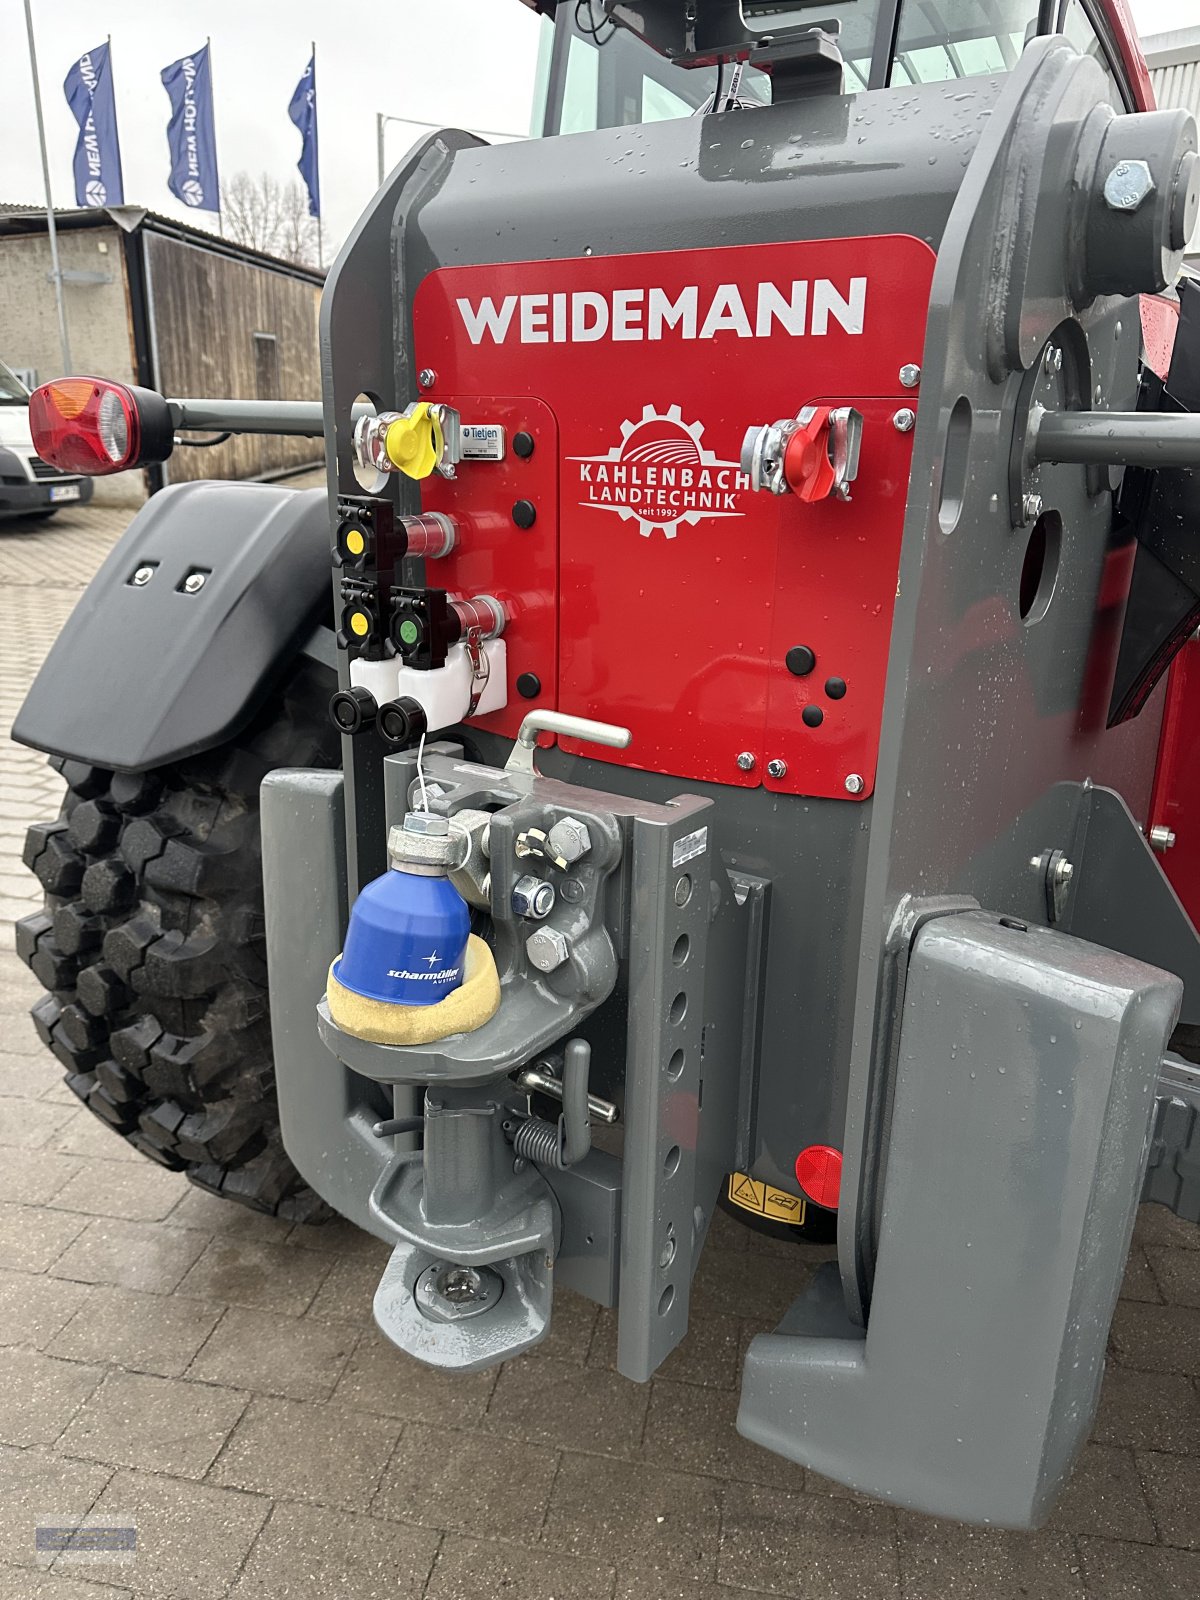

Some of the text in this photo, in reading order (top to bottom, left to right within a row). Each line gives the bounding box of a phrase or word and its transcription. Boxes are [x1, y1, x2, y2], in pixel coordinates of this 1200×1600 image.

[456, 276, 868, 345] WEIDEMANN
[471, 427, 497, 441] Tietjen
[580, 463, 750, 490] KAHLENBACH
[589, 485, 736, 509] LANDTECHNIK
[638, 507, 678, 517] seit 1992
[386, 968, 460, 980] scharmüller
